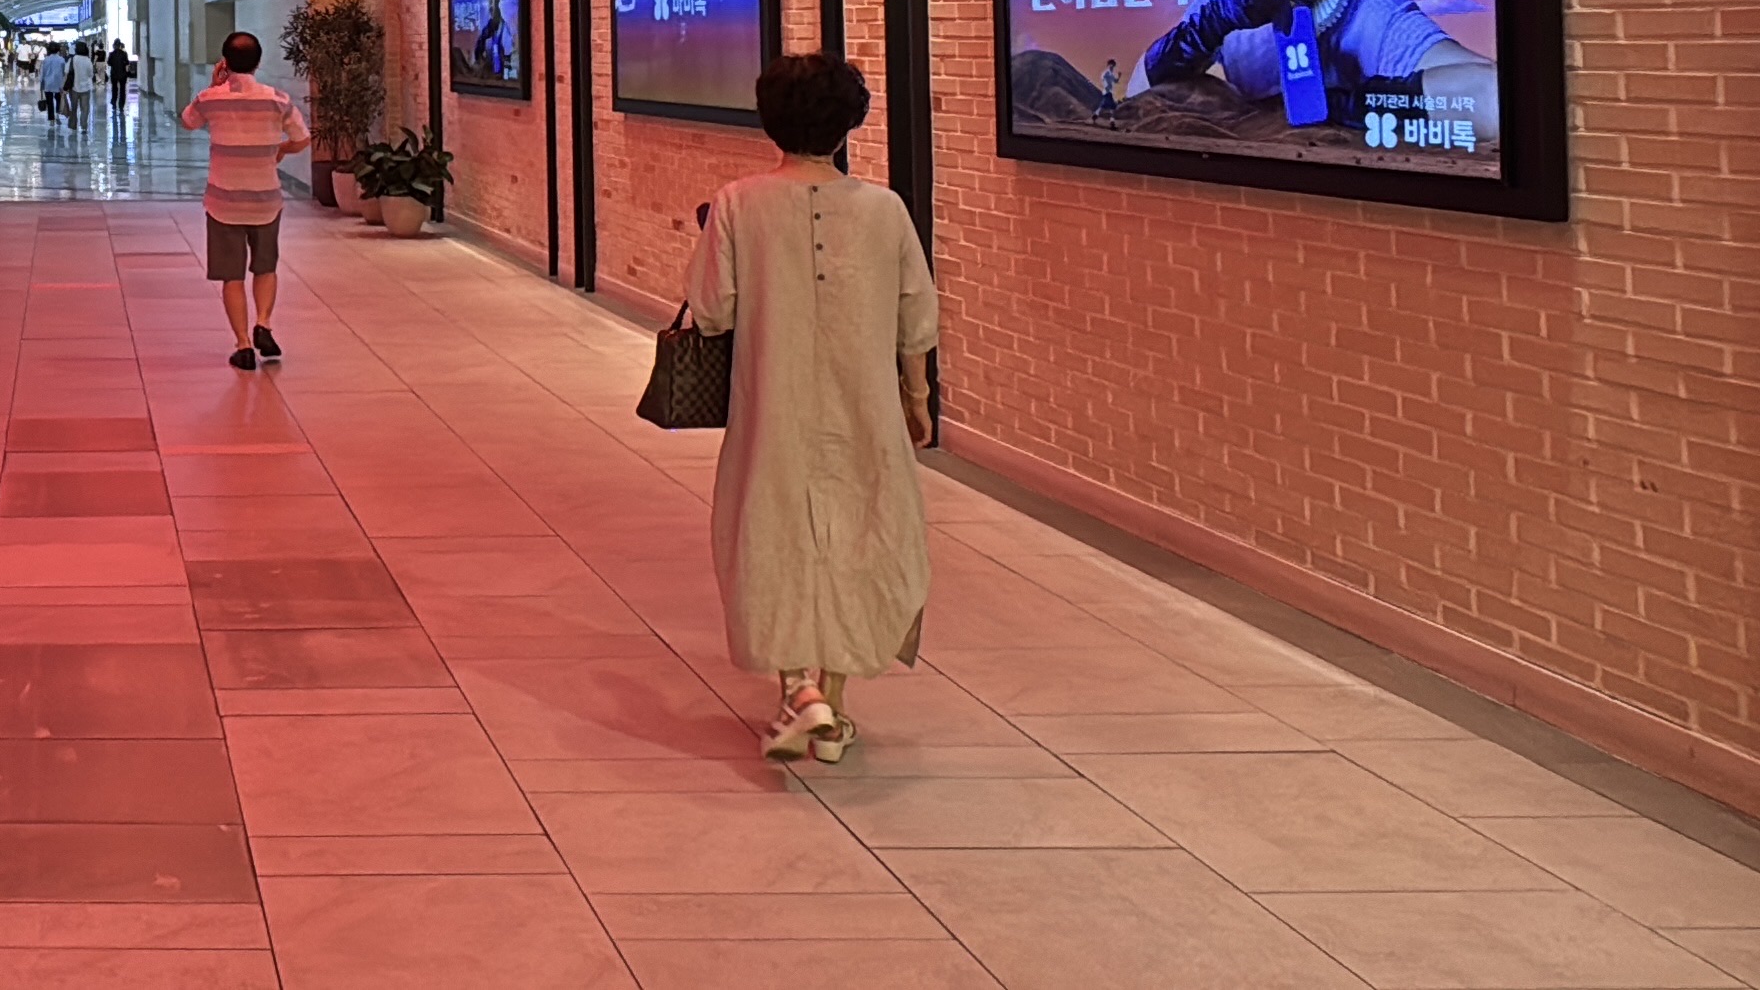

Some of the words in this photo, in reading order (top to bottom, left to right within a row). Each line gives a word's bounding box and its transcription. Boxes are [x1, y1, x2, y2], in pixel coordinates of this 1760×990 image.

[1364, 93, 1410, 110] 자기관리
[1411, 94, 1447, 111] 시술의
[1450, 95, 1476, 112] 시작
[1403, 117, 1477, 153] 바비톡
